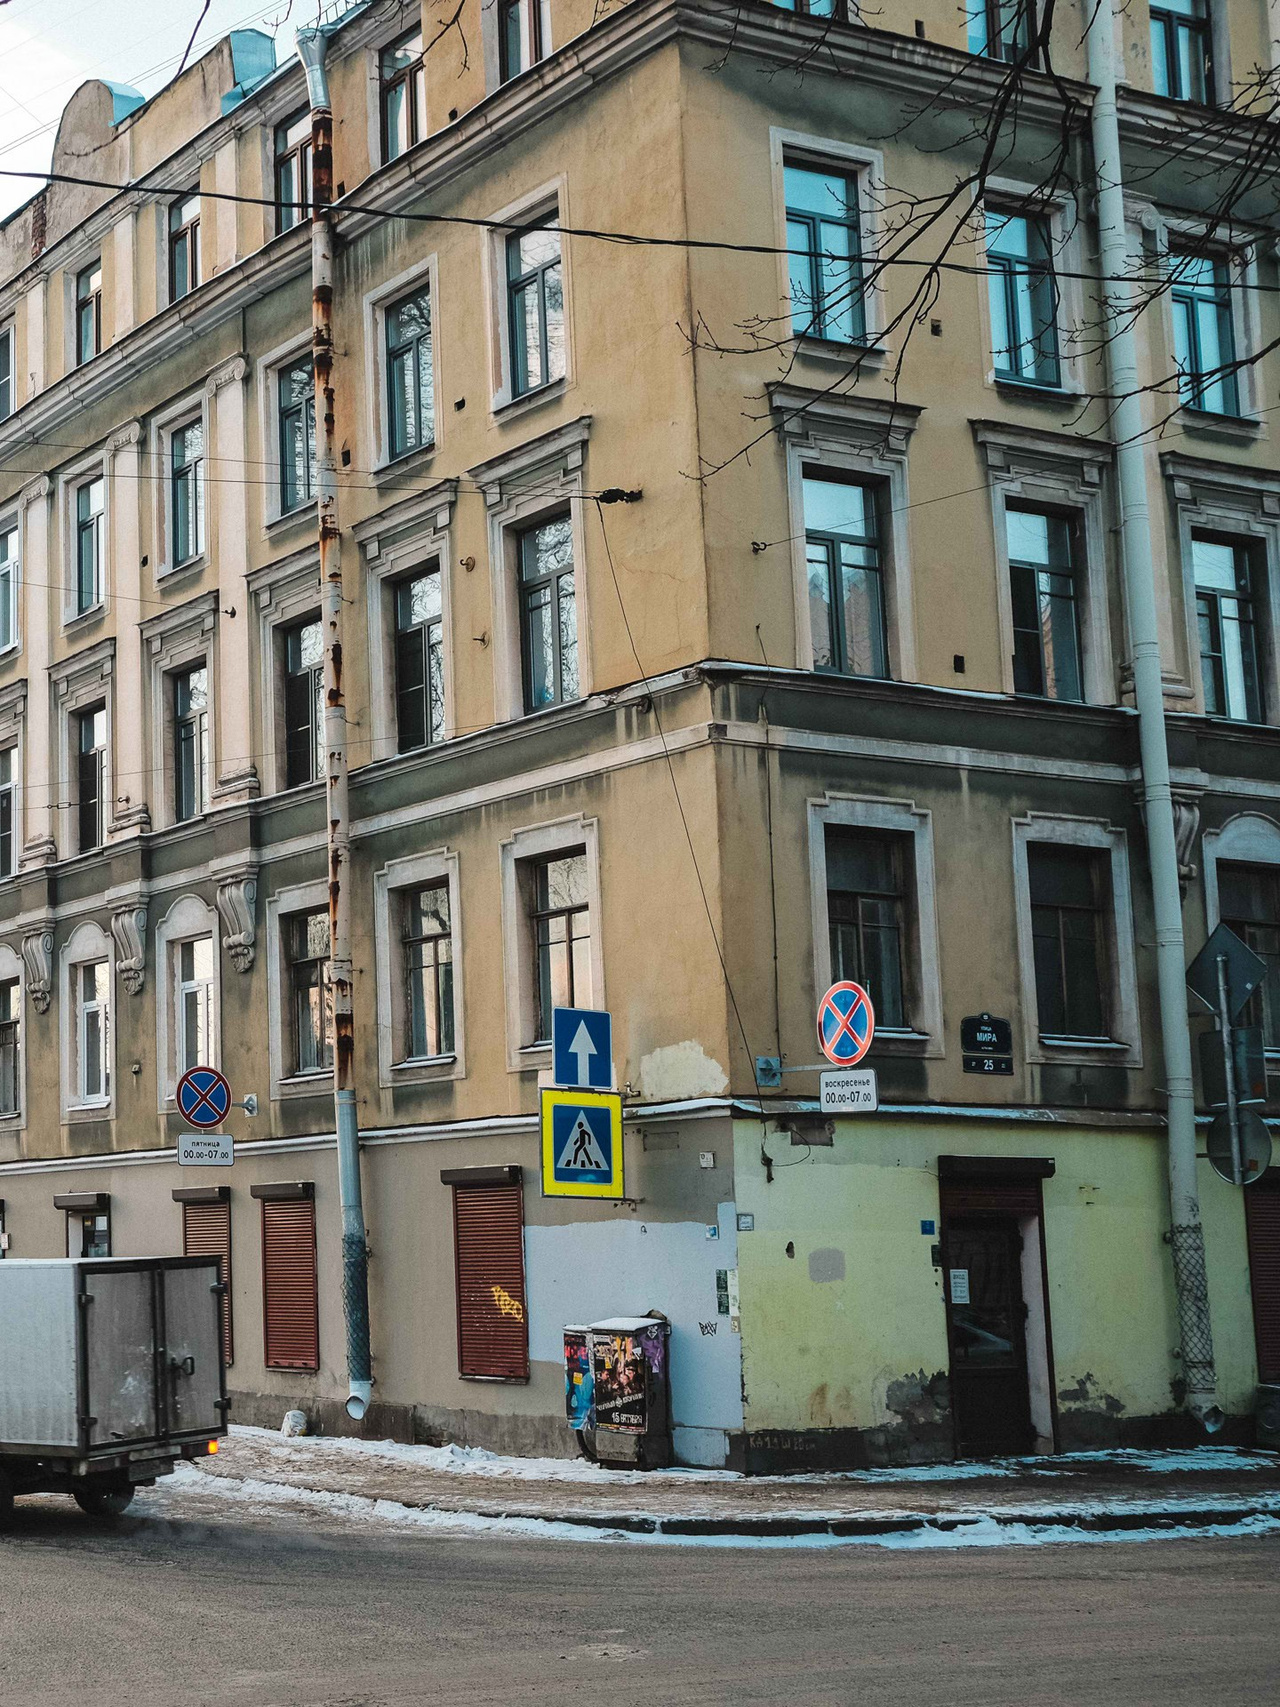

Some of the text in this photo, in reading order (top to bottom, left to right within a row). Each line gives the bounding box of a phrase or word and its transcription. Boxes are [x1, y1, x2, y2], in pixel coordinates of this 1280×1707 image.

[976, 1033, 998, 1042] МИРА
[983, 1060, 994, 1070] 25
[825, 1079, 870, 1089] воскресенье
[825, 1091, 871, 1104] 00.00-07.00
[183, 1150, 229, 1159] 00.00-07.00
[612, 1412, 620, 1423] 15
